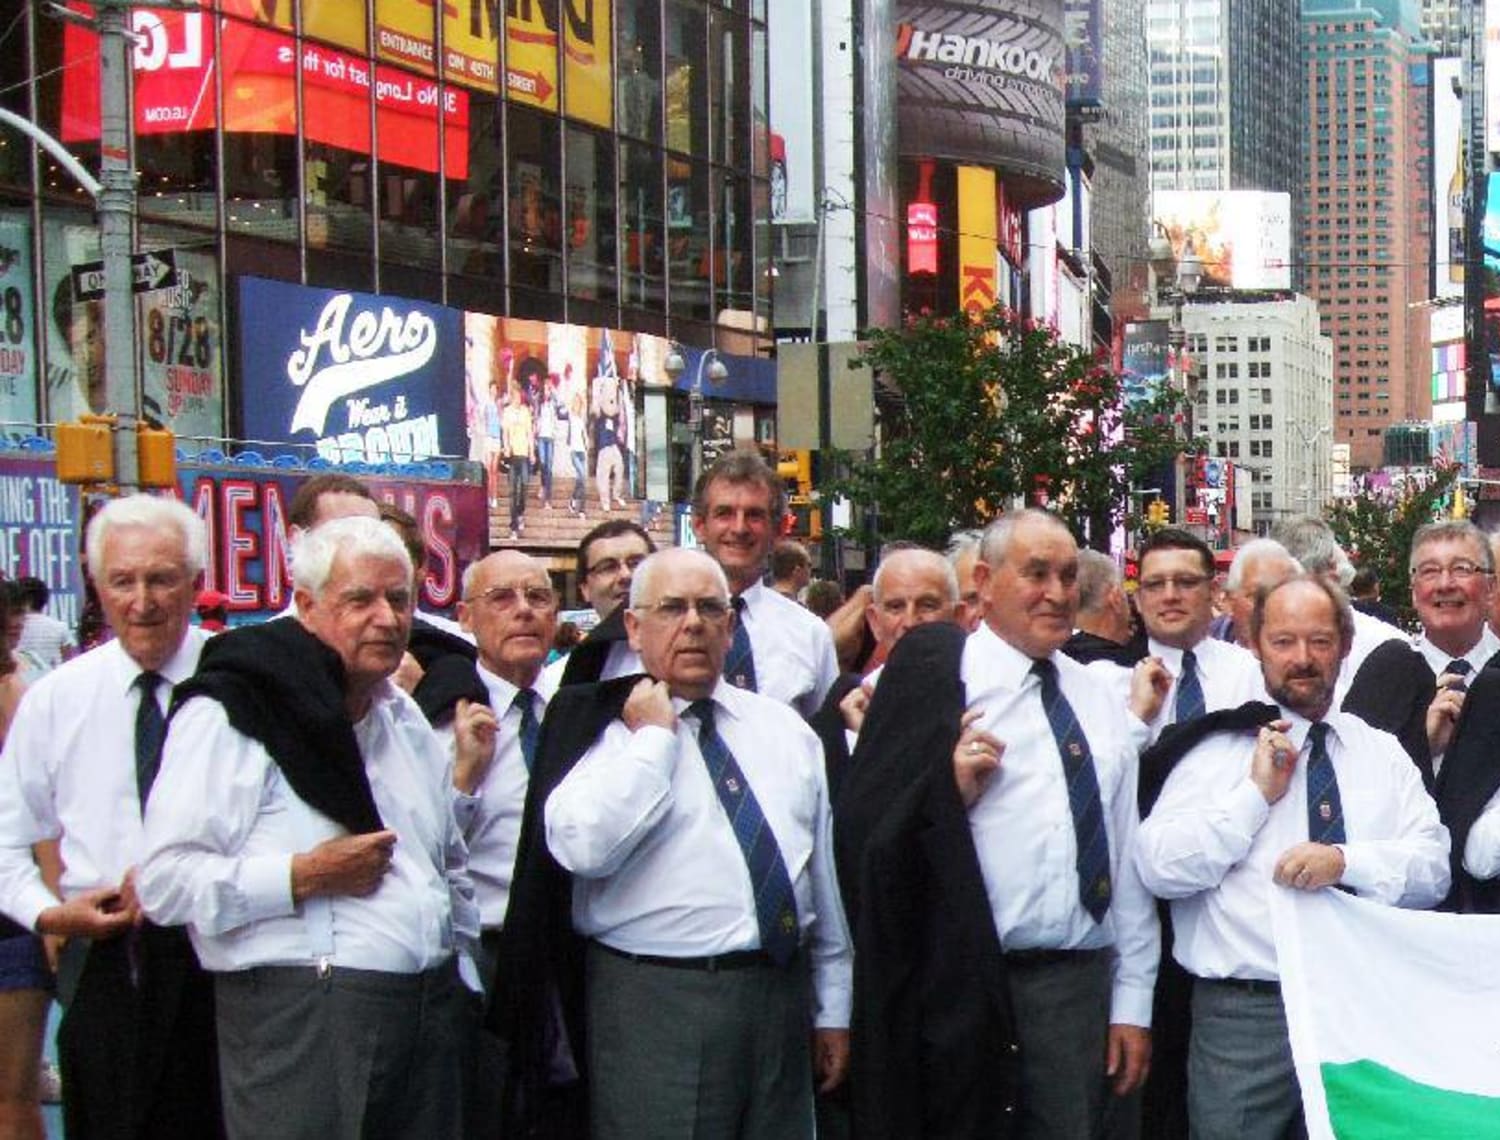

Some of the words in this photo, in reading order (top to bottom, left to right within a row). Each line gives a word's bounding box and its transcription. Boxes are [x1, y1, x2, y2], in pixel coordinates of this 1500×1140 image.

[381, 31, 433, 61] ENTRANCE
[448, 53, 465, 71] ON
[470, 62, 494, 82] 45TH
[507, 72, 536, 94] STREET
[945, 66, 1004, 90] driving
[149, 308, 210, 369] 8/28
[288, 293, 435, 386] Aero
[167, 367, 214, 397] SUNDAY
[38, 477, 73, 525] THE
[29, 529, 73, 589] OFF
